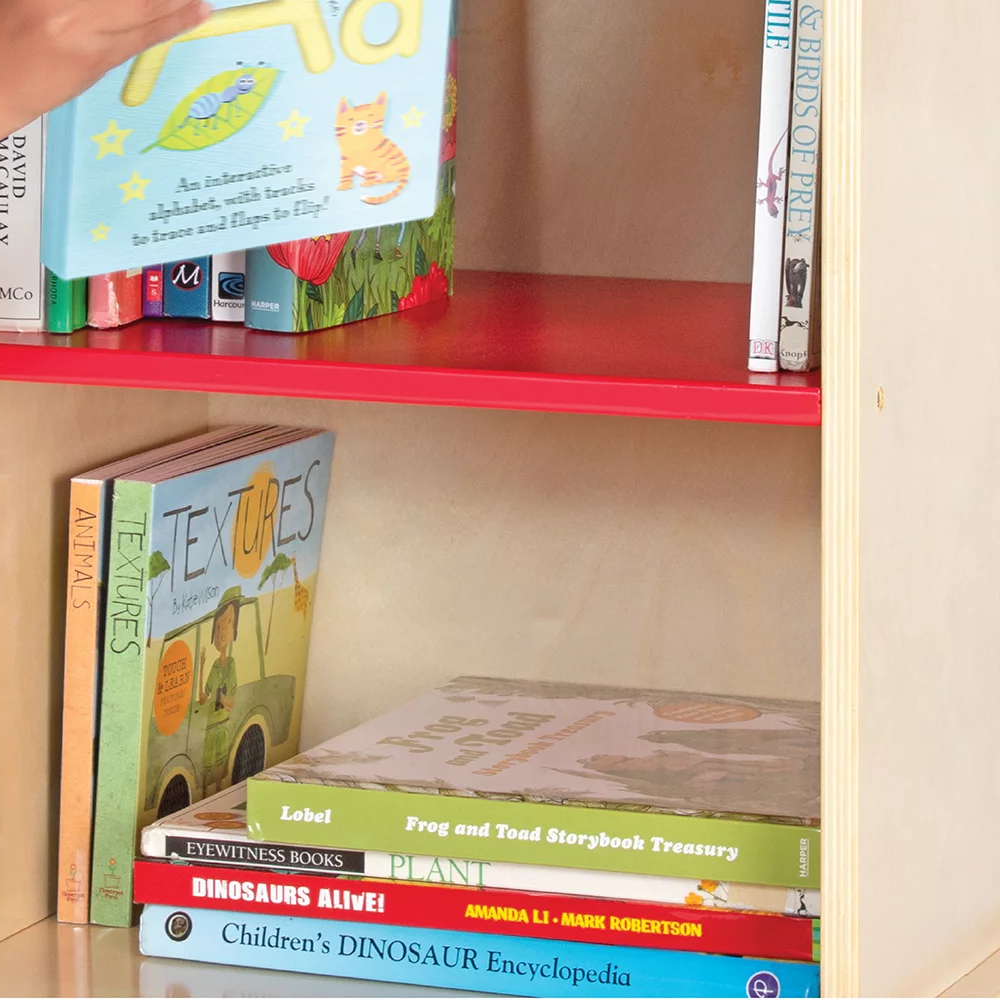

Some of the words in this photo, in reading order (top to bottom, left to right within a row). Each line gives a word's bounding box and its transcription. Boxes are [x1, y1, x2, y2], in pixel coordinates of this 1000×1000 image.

[799, 4, 823, 31] &
[795, 37, 822, 118] BIRDS
[792, 123, 818, 166] OF
[12, 135, 26, 199] DAVID
[174, 176, 201, 193] An
[204, 163, 294, 188] interactive
[223, 186, 262, 206] with
[264, 177, 316, 200] tracks
[786, 170, 815, 243] PREY
[131, 232, 150, 246] to
[152, 227, 195, 243] trace
[197, 215, 228, 235] and
[230, 210, 271, 230] flaps
[272, 206, 291, 220] to
[293, 195, 331, 219] flip!
[50, 275, 58, 305] RHODA
[213, 299, 245, 309] Harcour
[251, 300, 280, 311] HARPER
[753, 340, 774, 355] DK
[162, 459, 322, 593] TEXTURES
[70, 506, 98, 610] ANIMALS
[110, 511, 148, 656] TEXTURES
[375, 715, 489, 754] Frog
[454, 711, 557, 746] Toad
[445, 748, 489, 766] and
[471, 741, 554, 777] Storybook
[280, 805, 332, 824] Lobel
[186, 842, 285, 864] EYEWITNESS
[290, 851, 344, 868] BOOKS
[405, 816, 449, 836] Frog
[454, 822, 490, 837] and
[495, 823, 542, 842] Toad
[546, 827, 645, 851] Storybook
[650, 836, 739, 862] Treasury
[388, 853, 492, 887] PLANT
[799, 837, 808, 878] HARPER
[191, 877, 311, 908] DINOSAURS
[464, 904, 530, 924] AMANDA
[532, 909, 549, 925] LI
[561, 912, 606, 930] MARK
[609, 916, 703, 938] ROBERTSON
[338, 934, 479, 971] DINOSAUR
[486, 951, 632, 987] Encyclopedia
